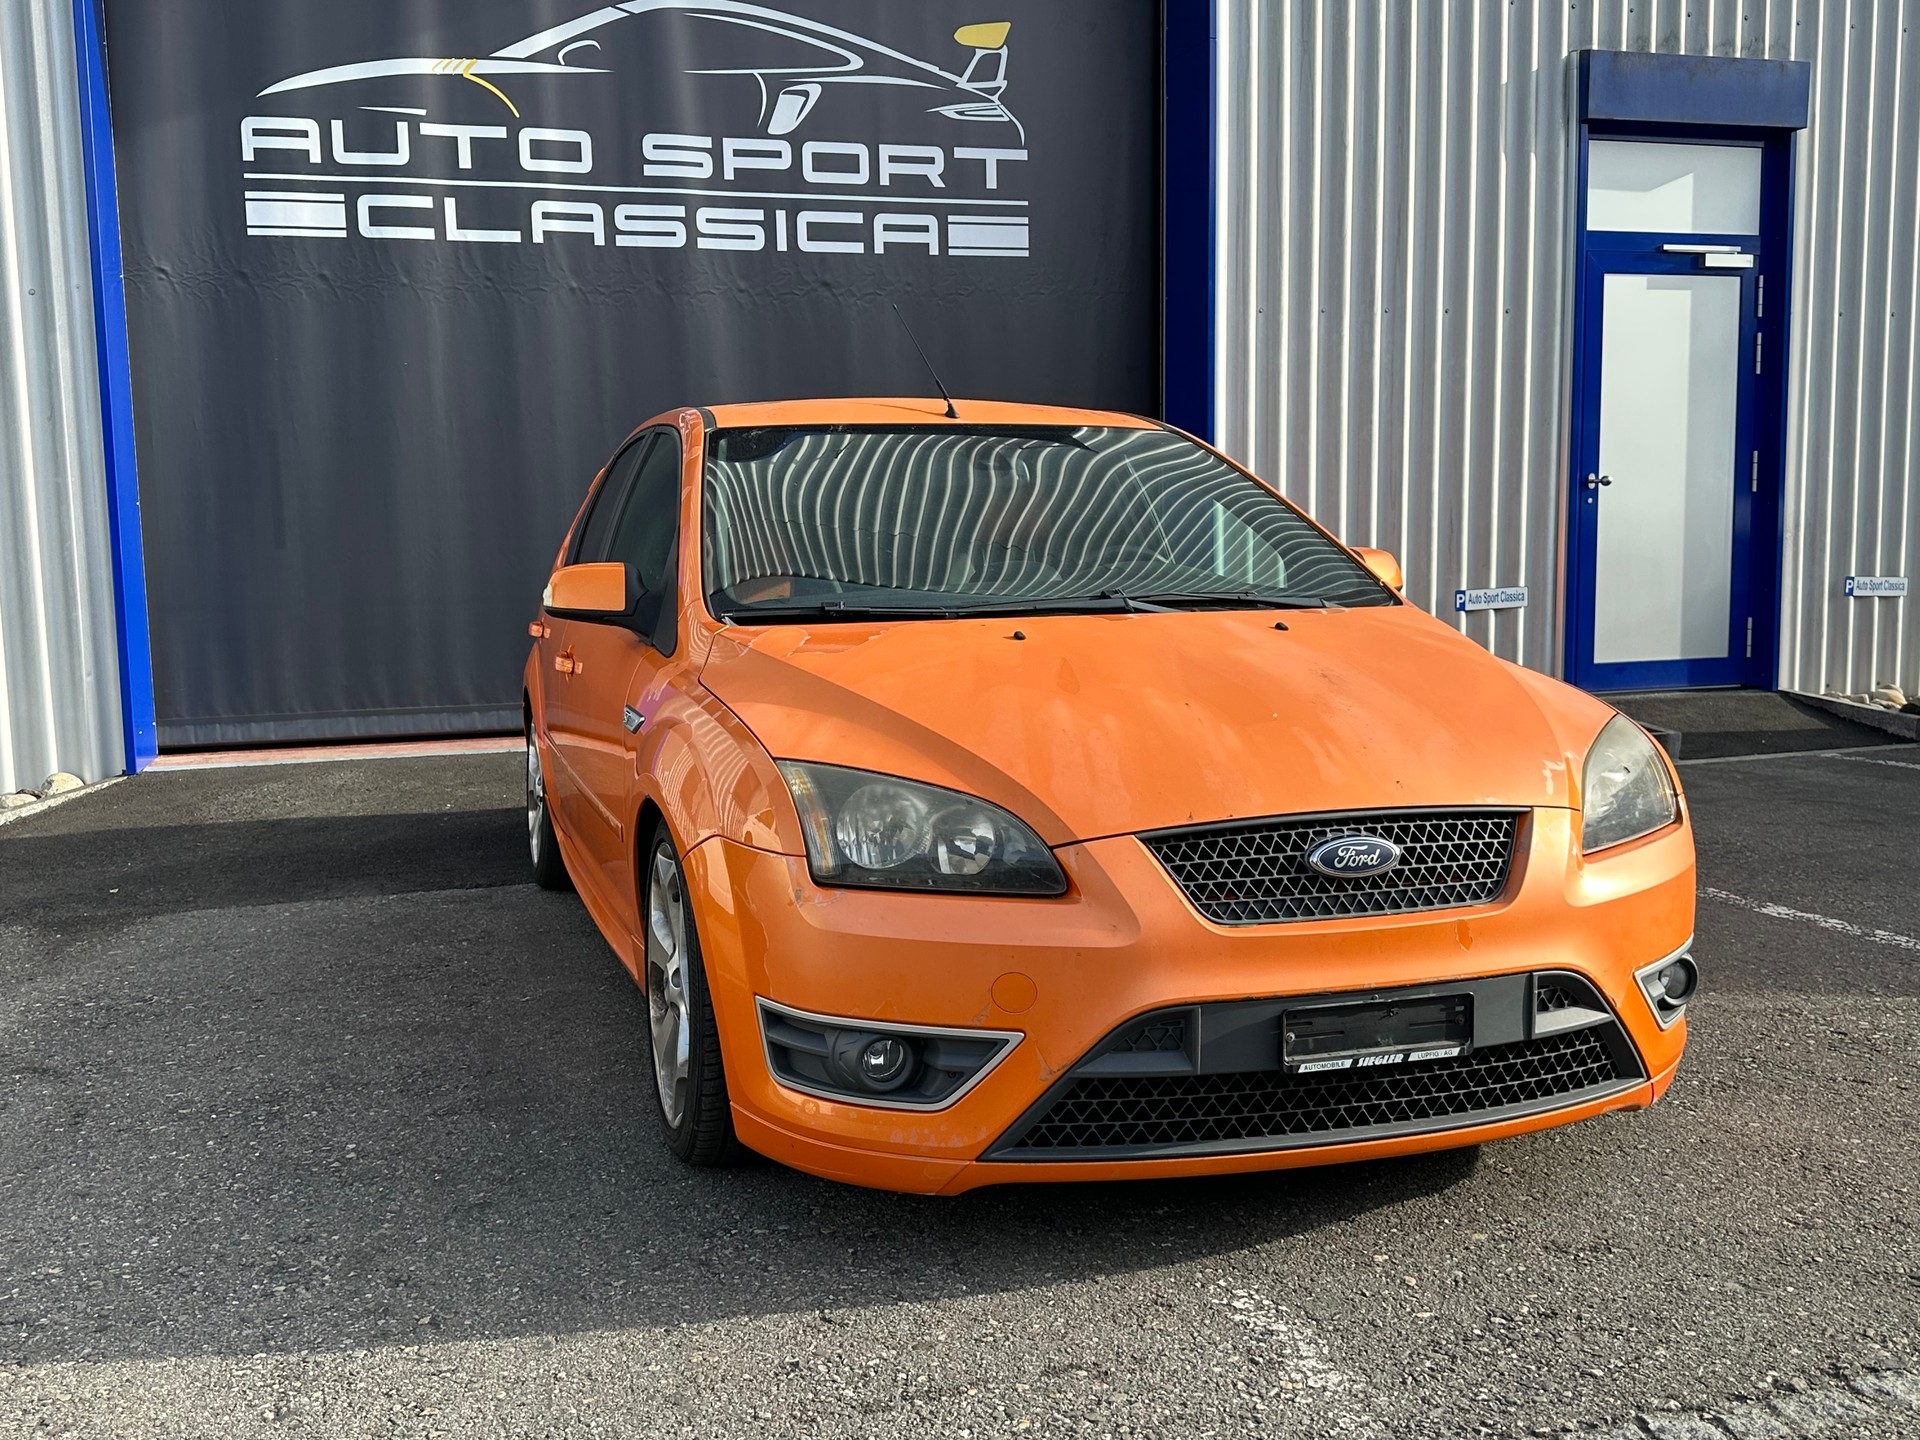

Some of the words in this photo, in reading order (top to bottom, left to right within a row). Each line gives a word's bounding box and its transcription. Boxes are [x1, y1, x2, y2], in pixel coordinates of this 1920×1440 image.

[240, 115, 593, 173] AUTO
[642, 133, 1028, 189] SPORT
[356, 195, 939, 255] CLASSICA
[1845, 579, 1853, 593] P
[1856, 579, 1868, 590] Auto
[1869, 579, 1883, 593] Sport
[1456, 594, 1465, 608] P
[1468, 593, 1482, 604] Auto
[1483, 592, 1499, 605] Sport
[1500, 590, 1525, 603] Classica
[1334, 845, 1380, 868] Ford
[1303, 1061, 1346, 1071] AUTOMOBILE
